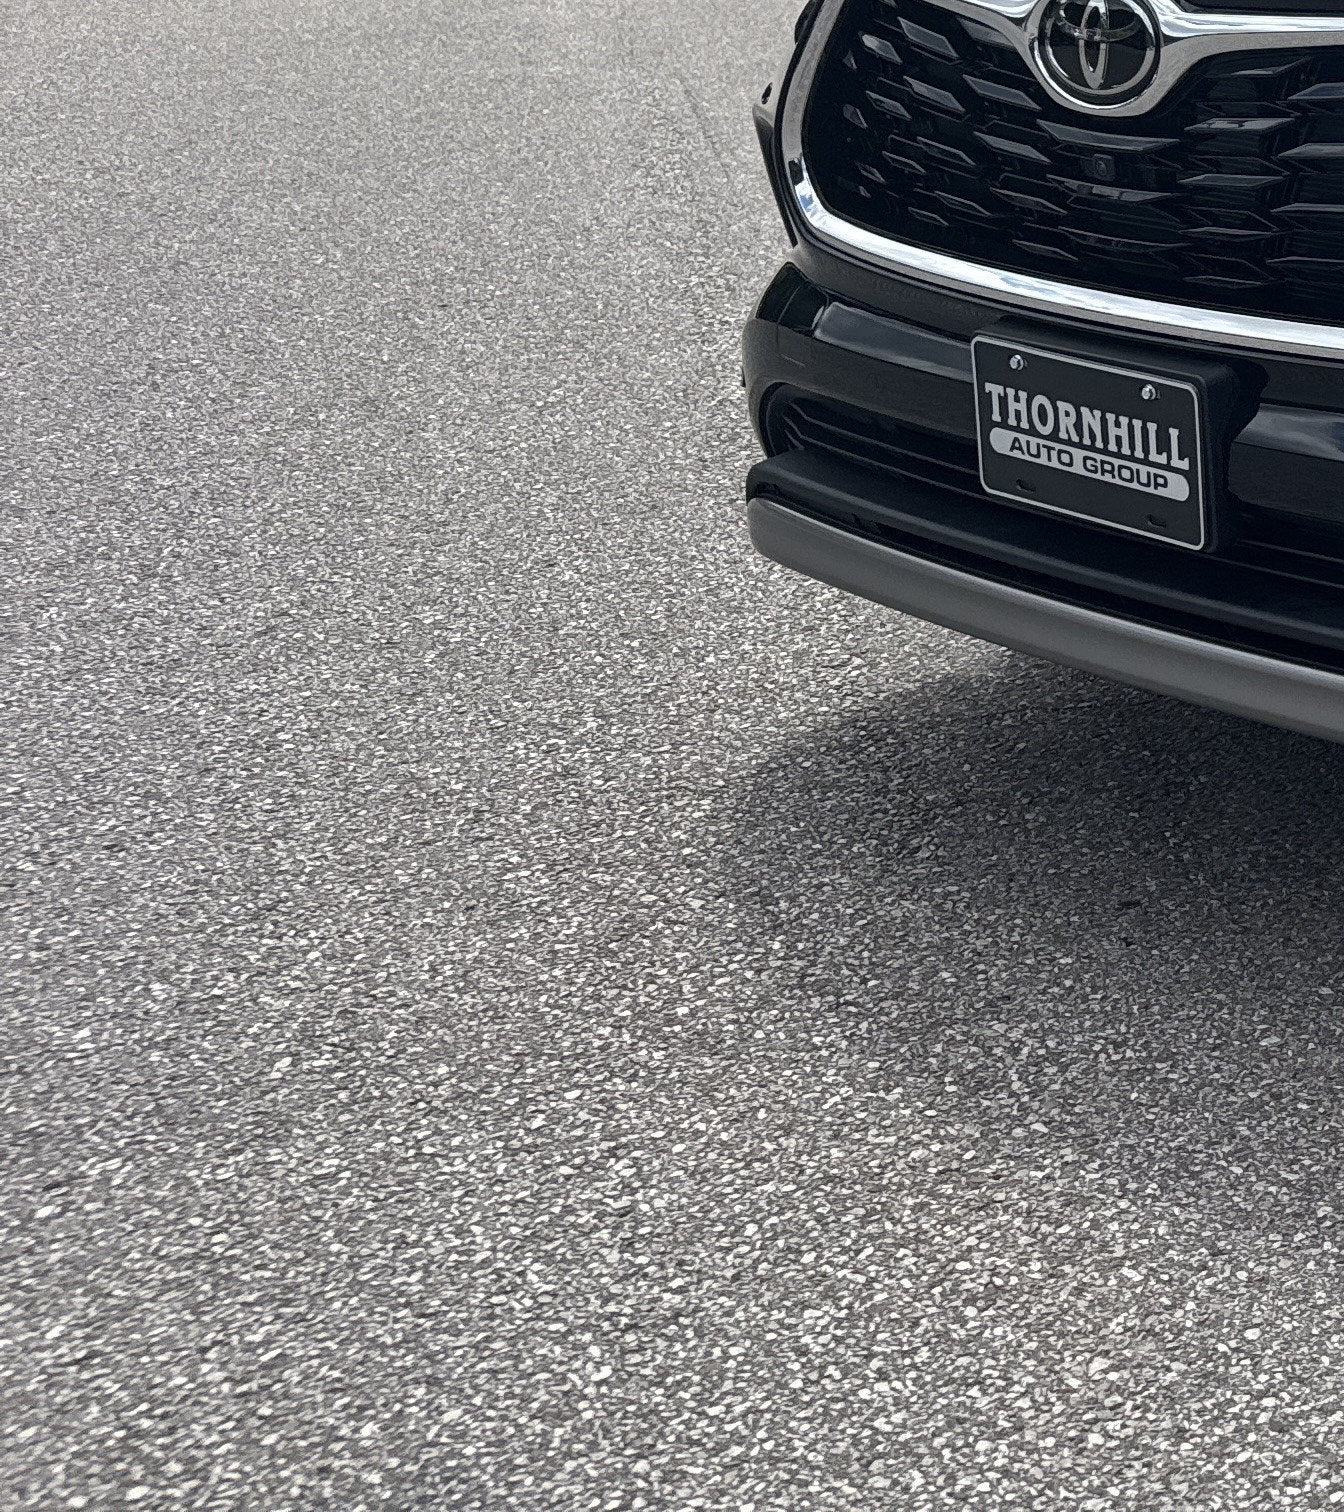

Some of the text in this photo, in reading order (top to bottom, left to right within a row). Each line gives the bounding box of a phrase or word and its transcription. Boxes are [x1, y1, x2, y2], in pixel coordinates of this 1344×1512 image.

[984, 382, 1190, 471] THORNHILL
[1009, 437, 1168, 490] AUTO GROUP
